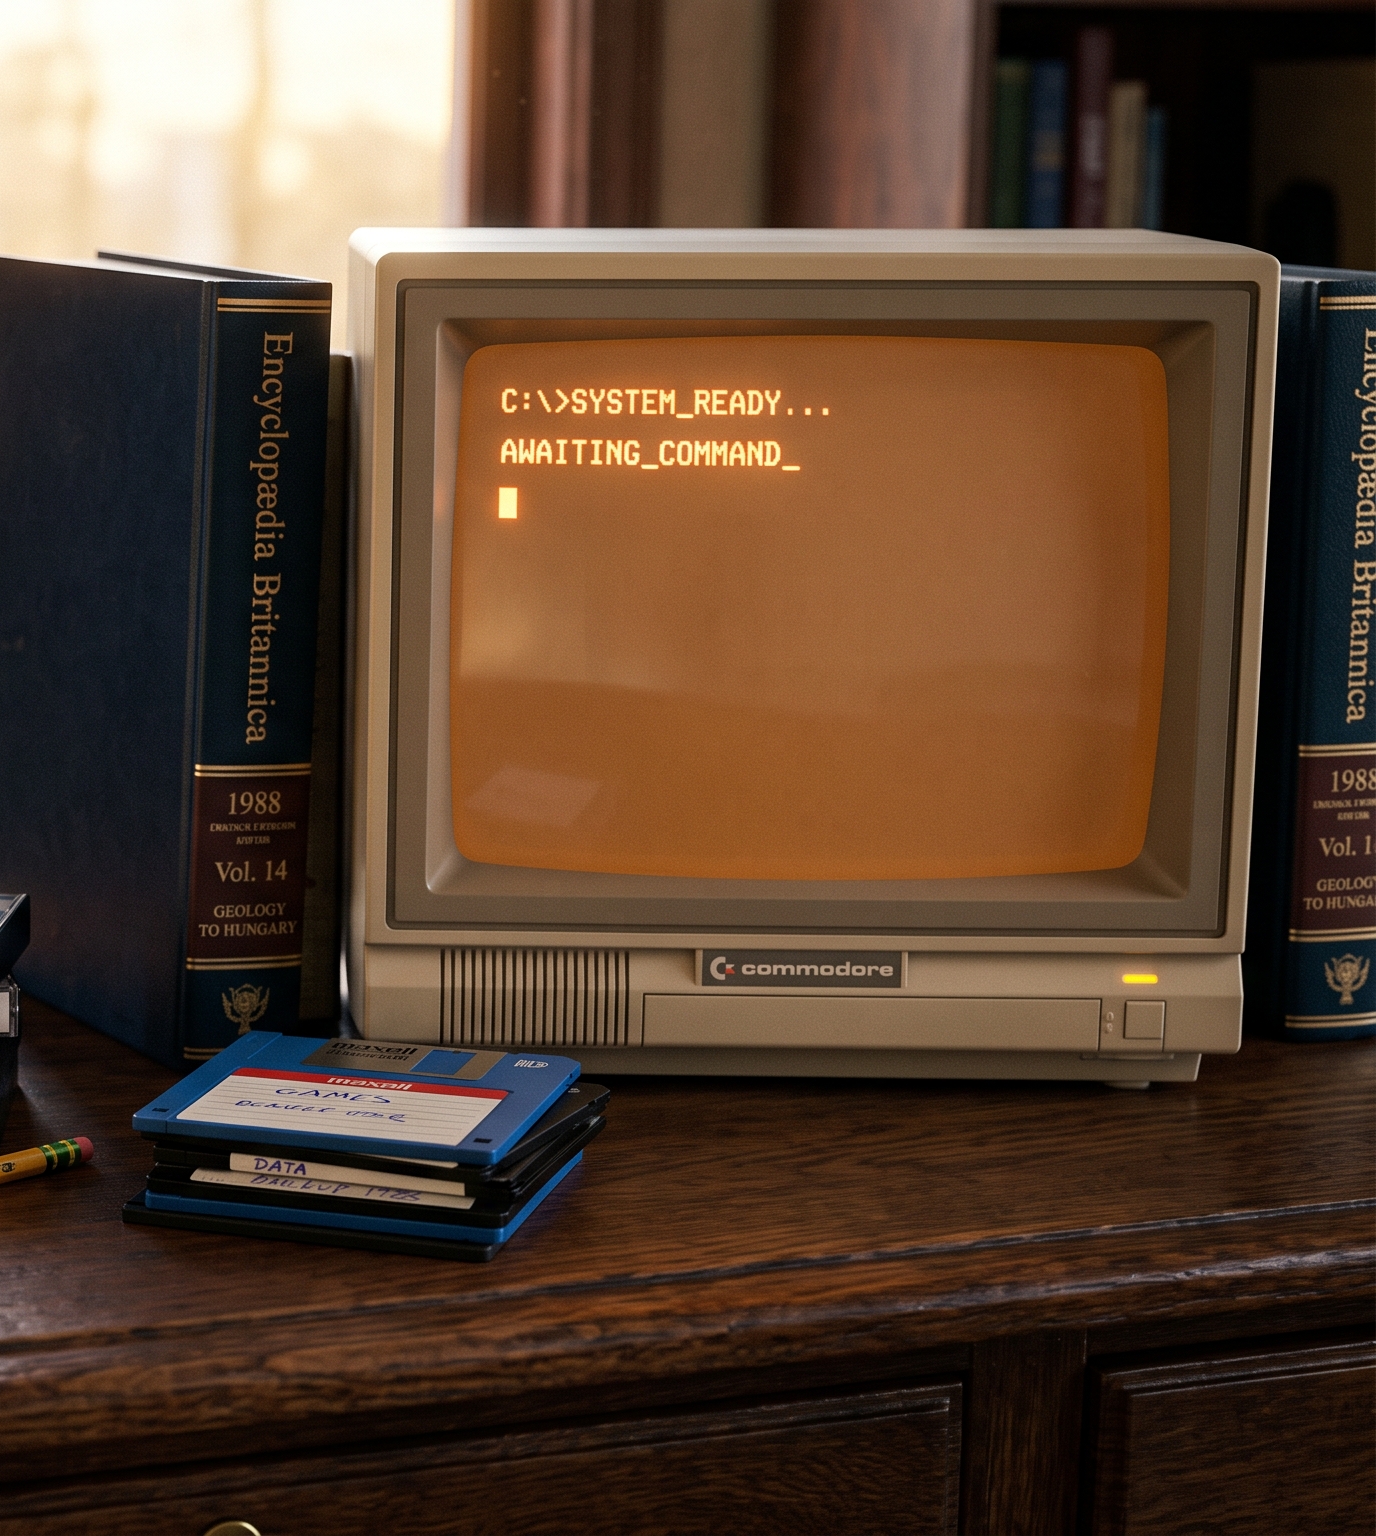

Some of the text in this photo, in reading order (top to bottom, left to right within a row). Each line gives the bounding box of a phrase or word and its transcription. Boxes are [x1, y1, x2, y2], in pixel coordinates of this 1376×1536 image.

[501, 388, 829, 419] C:\>SYSTEM_READY...
[500, 438, 801, 471] AWAITING_COMMAND_
[246, 331, 294, 745] Encyclopædia Britannica
[1346, 559, 1376, 724] Britannica
[228, 791, 281, 815] 1988
[1318, 835, 1376, 857] Vol. 1
[215, 859, 288, 883] Vol. 14
[1316, 876, 1376, 892] GEOLOG
[213, 903, 287, 918] GEOLOGY
[1303, 897, 1323, 910] TO
[199, 921, 297, 937] TO HUNGARY
[741, 961, 894, 977] commodore
[331, 1042, 418, 1055] maxell
[327, 1077, 413, 1091] maxell
[253, 1157, 307, 1176] DATA
